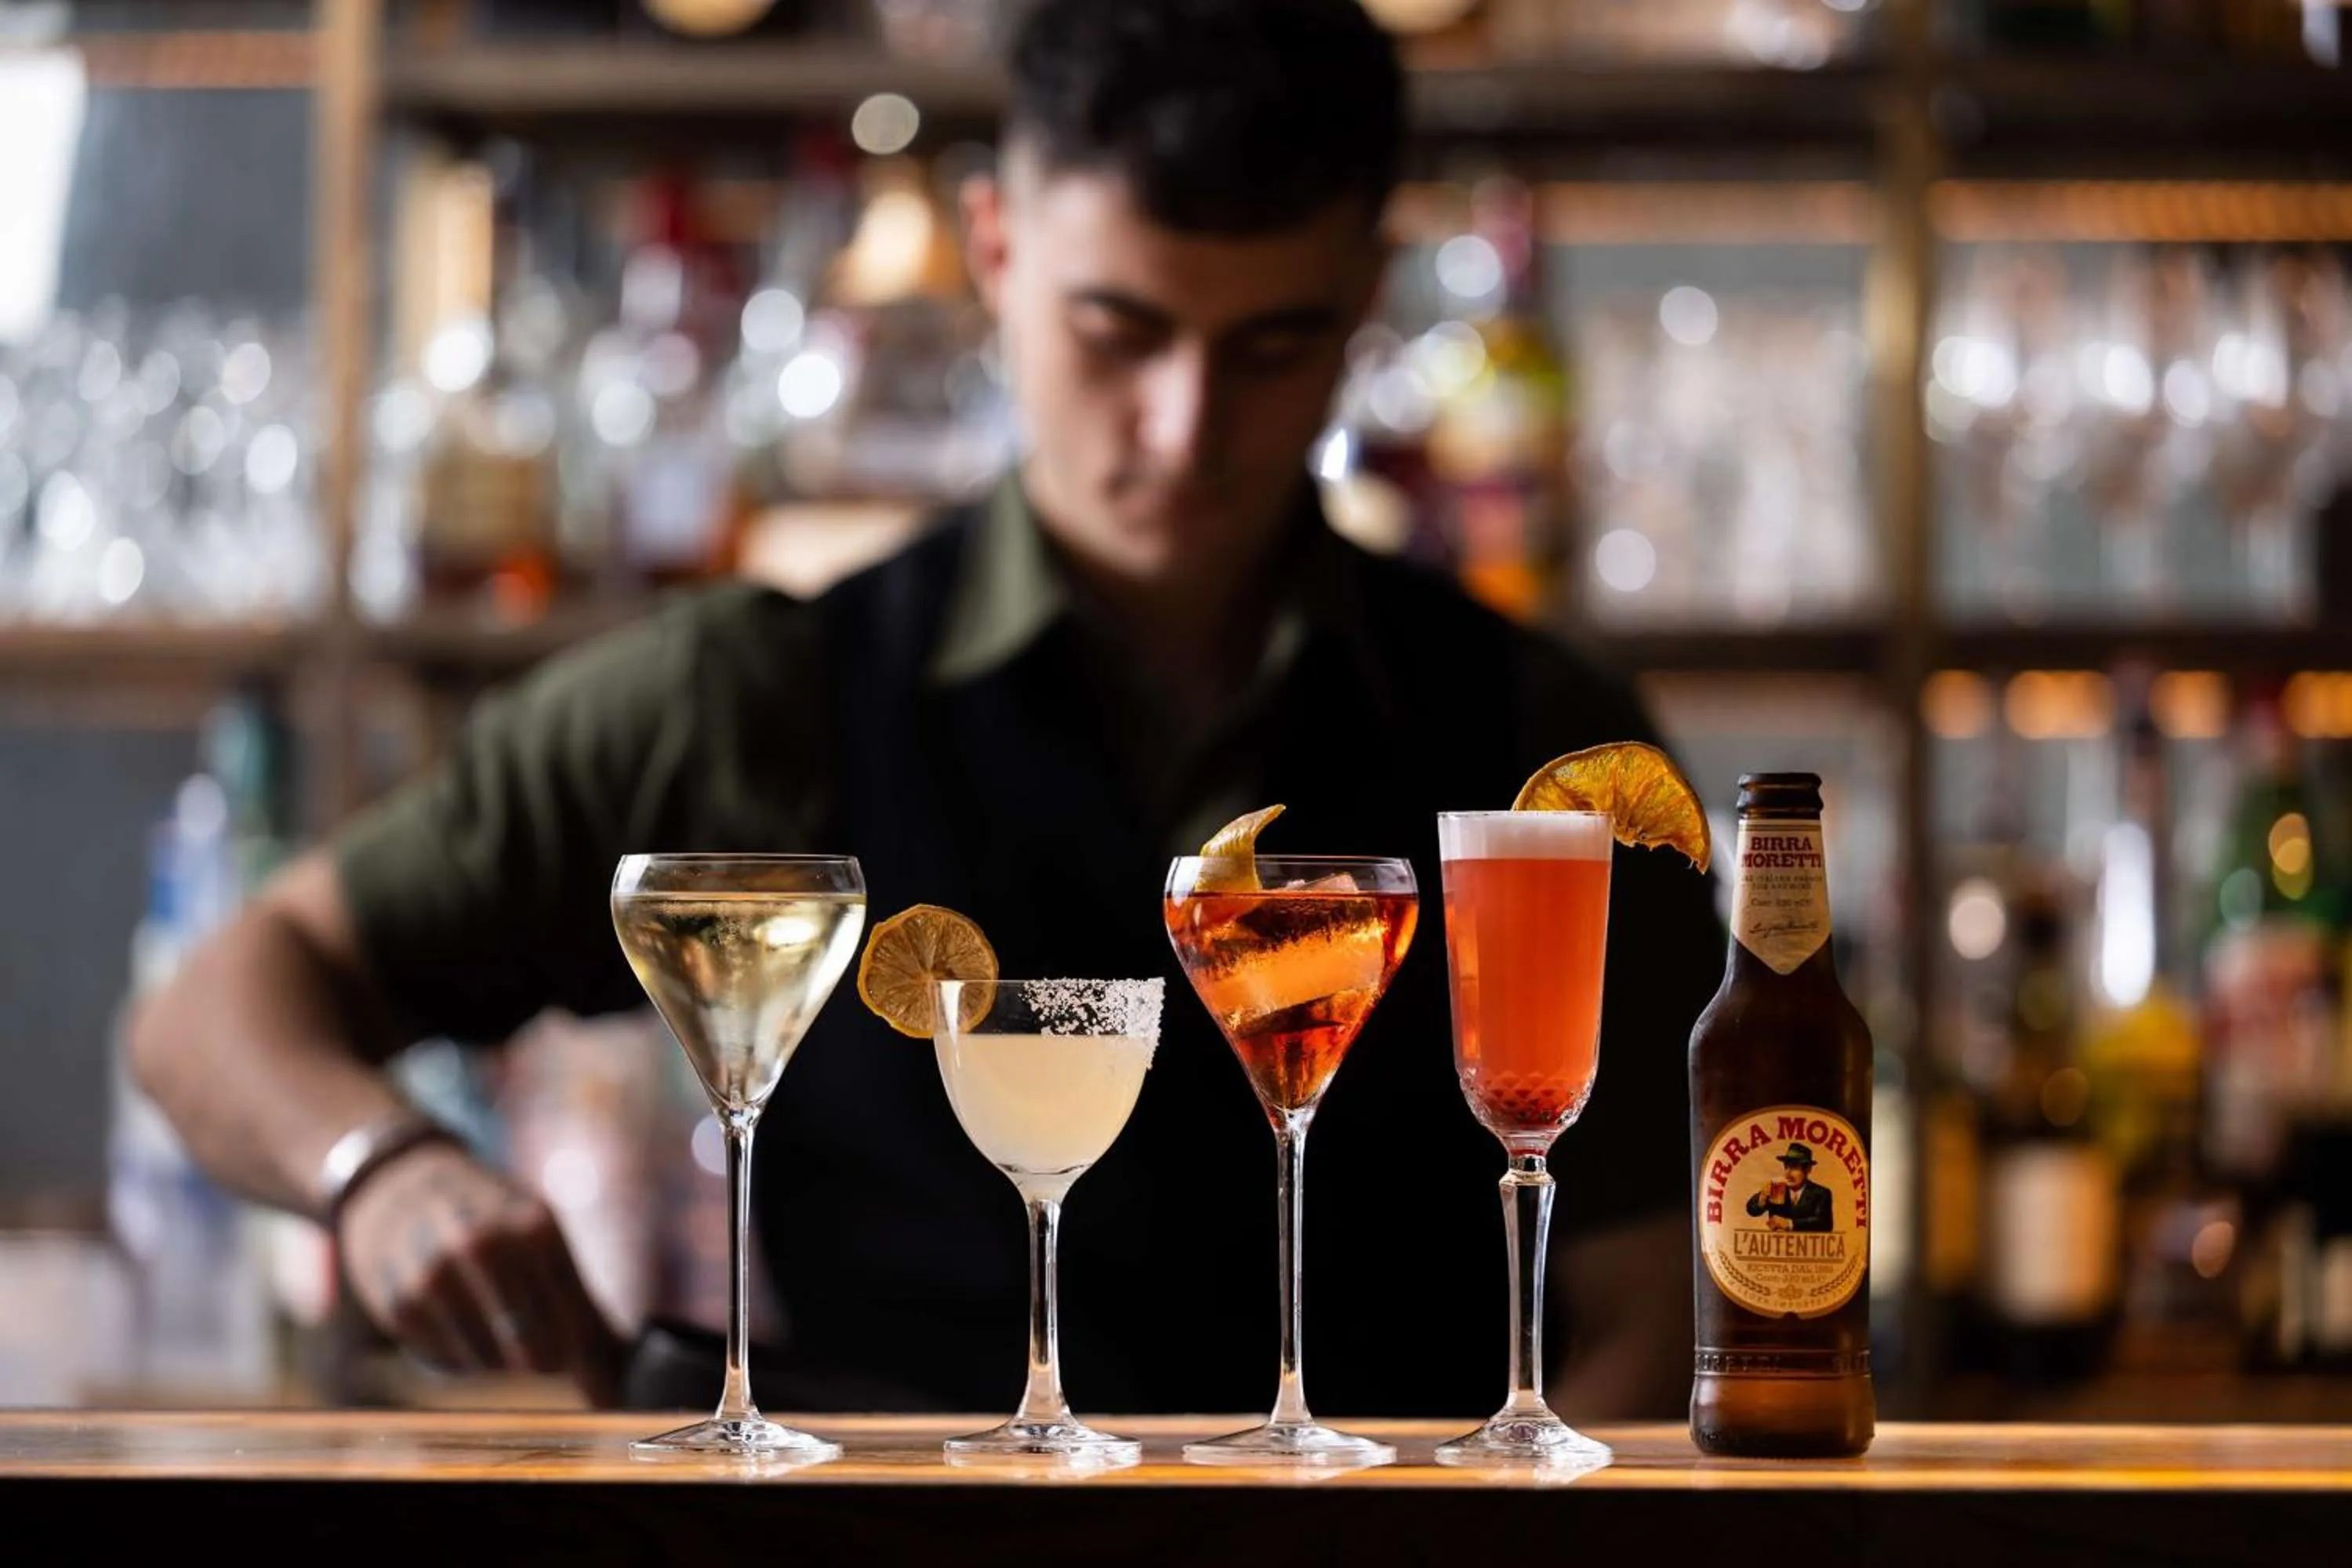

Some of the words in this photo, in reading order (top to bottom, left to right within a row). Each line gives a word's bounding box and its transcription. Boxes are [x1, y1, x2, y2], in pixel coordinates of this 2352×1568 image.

[1751, 837, 1813, 851] BIRRA
[1741, 853, 1822, 867] MORETTI
[1707, 1123, 1772, 1225] BIRRA
[1777, 1116, 1867, 1229] MORETTI
[1733, 1232, 1845, 1257] L'AUTENTICA
